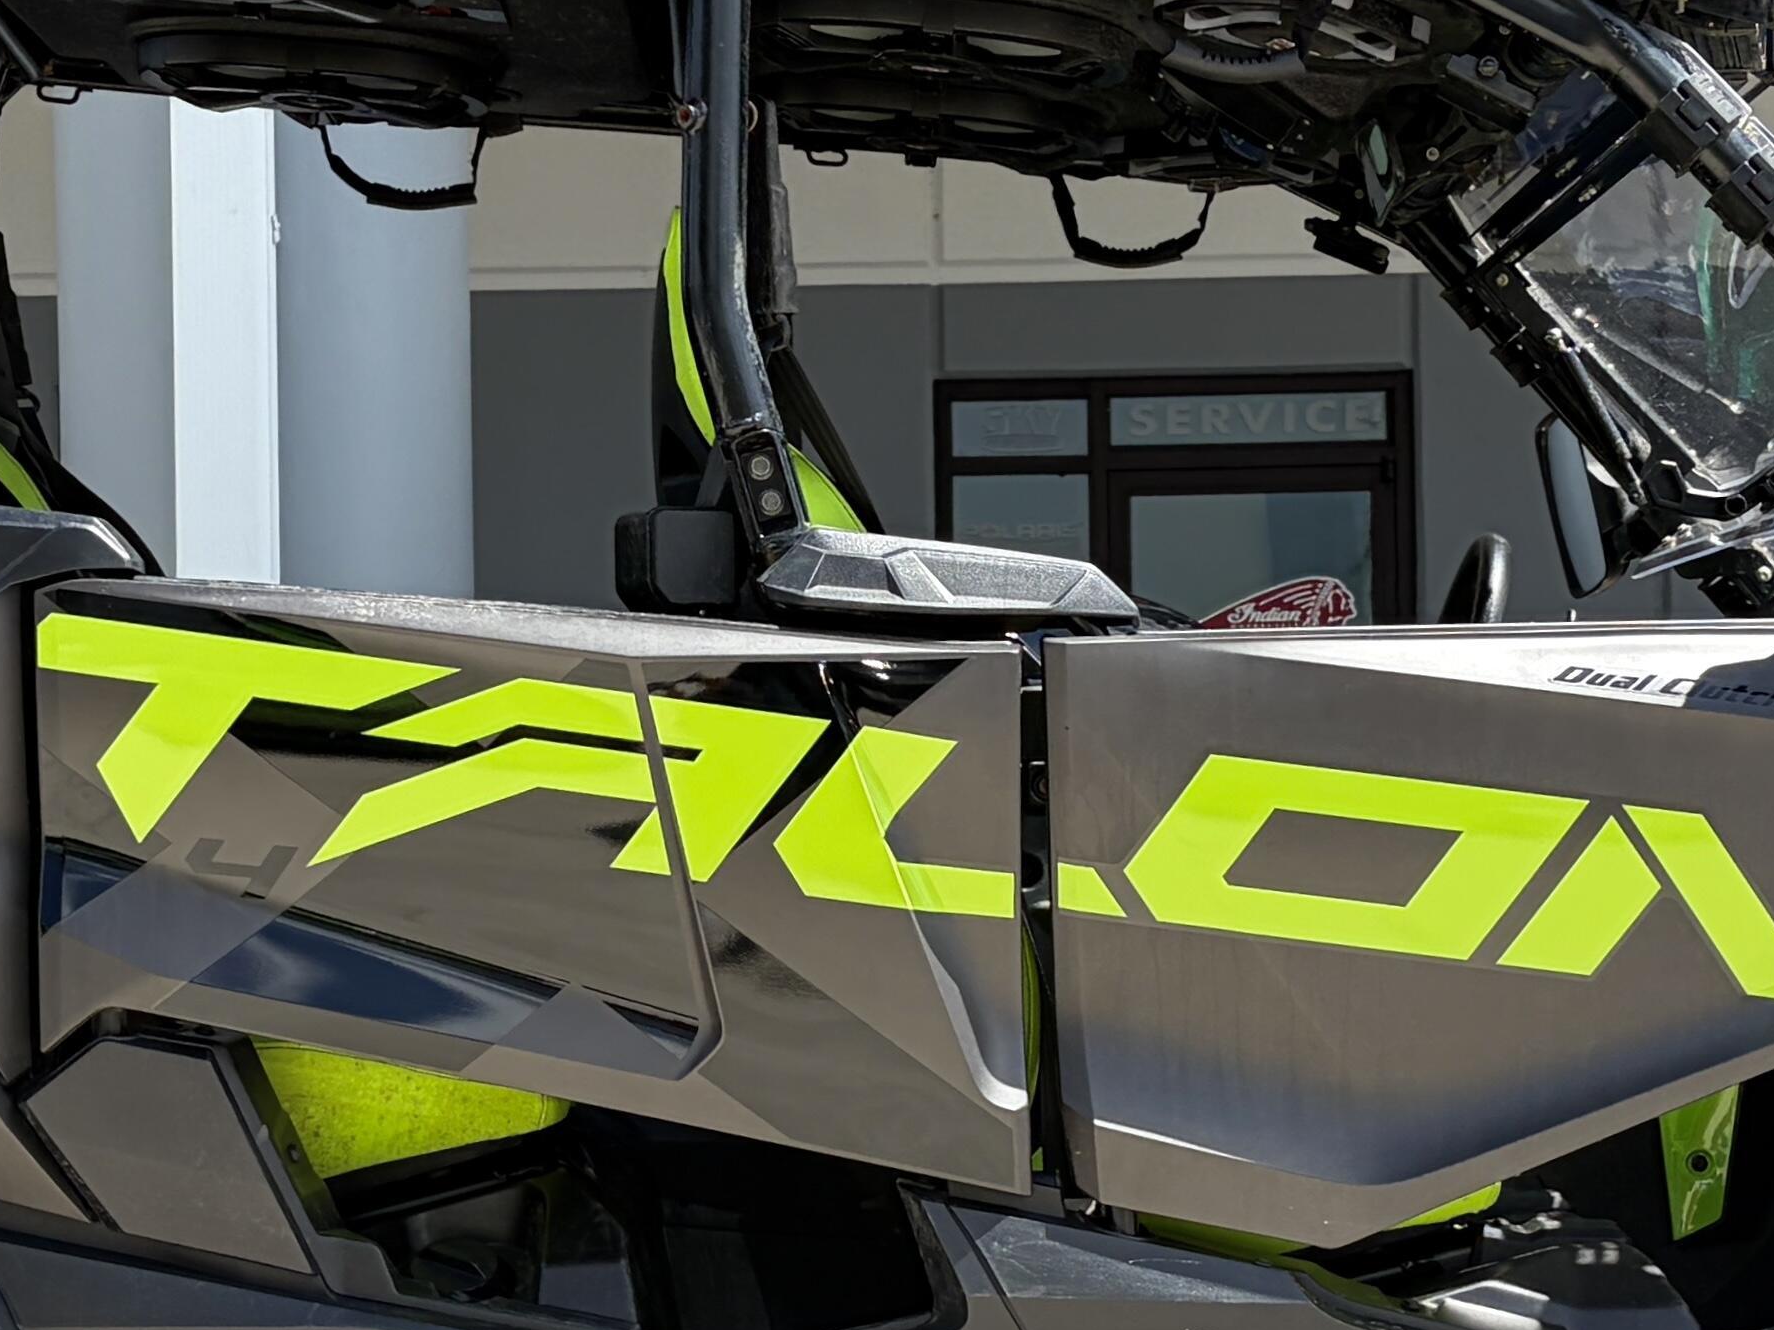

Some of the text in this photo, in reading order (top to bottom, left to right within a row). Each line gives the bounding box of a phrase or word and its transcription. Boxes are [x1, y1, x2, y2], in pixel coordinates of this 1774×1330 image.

[1129, 399, 1372, 437] SERVICE
[1227, 601, 1302, 624] Indian
[1553, 665, 1656, 693] Dual
